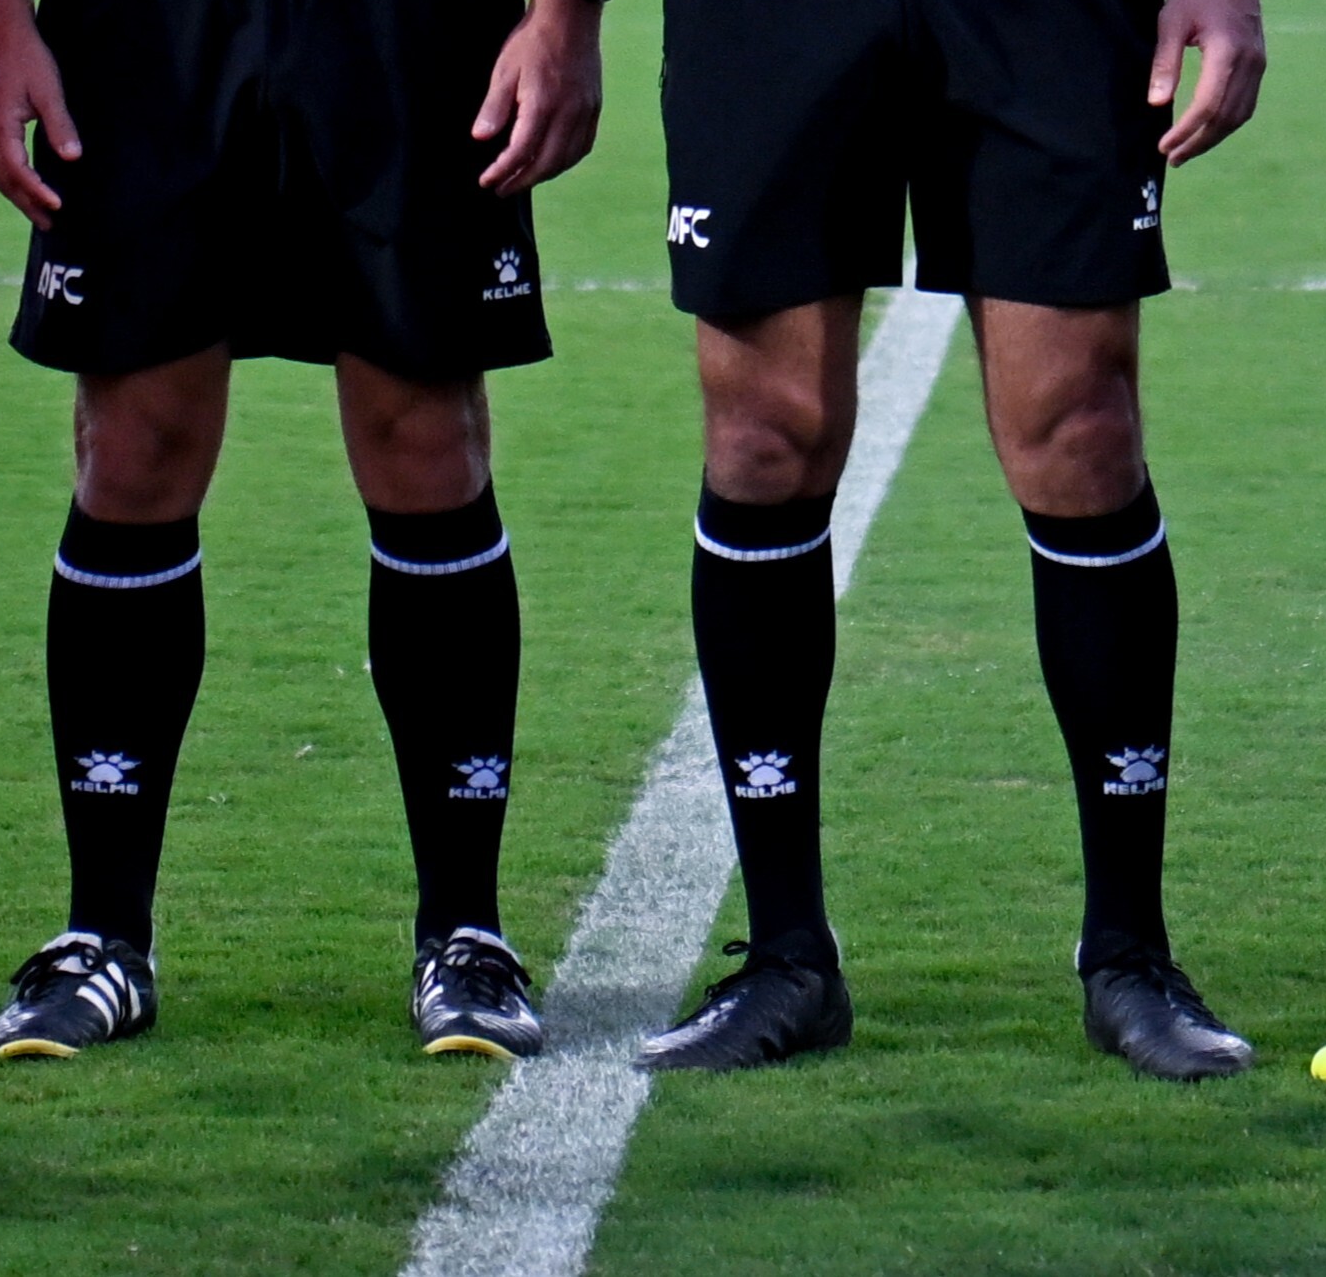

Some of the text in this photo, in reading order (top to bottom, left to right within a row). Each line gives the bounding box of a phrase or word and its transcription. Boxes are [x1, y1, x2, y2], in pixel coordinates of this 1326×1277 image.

[667, 204, 711, 248] AFC
[37, 261, 85, 305] AFC
[482, 283, 532, 301] KELME
[71, 780, 138, 795] KELME
[735, 780, 796, 799] KELME
[1103, 777, 1165, 795] KELME
